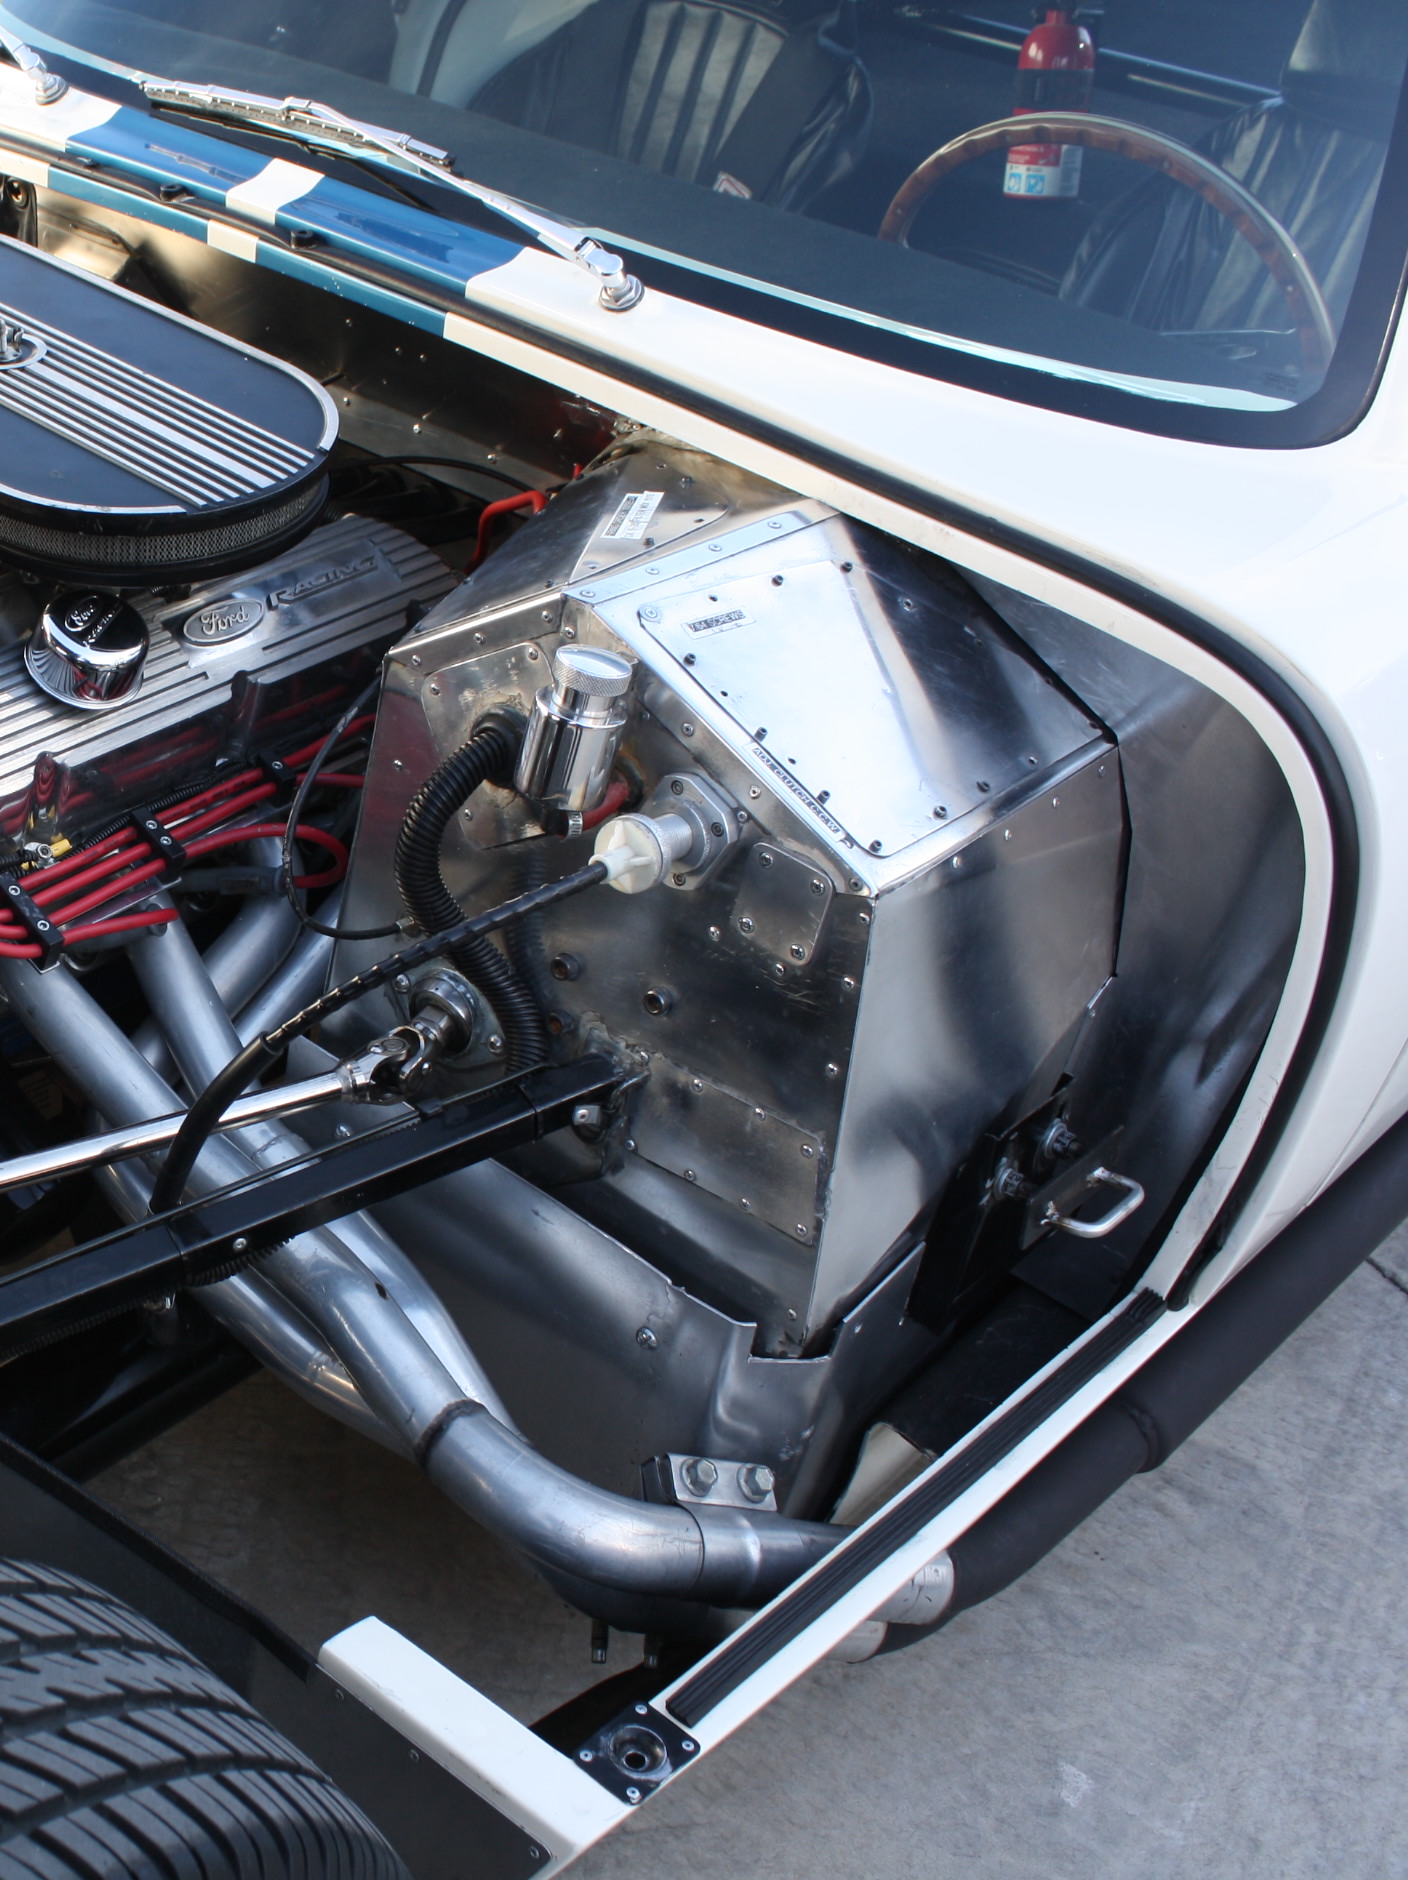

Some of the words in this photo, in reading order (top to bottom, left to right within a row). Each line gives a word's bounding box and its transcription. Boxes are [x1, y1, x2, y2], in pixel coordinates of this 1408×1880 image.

[200, 604, 250, 635] Ford
[266, 555, 378, 611] RACING
[773, 767, 811, 805] CLUTCH
